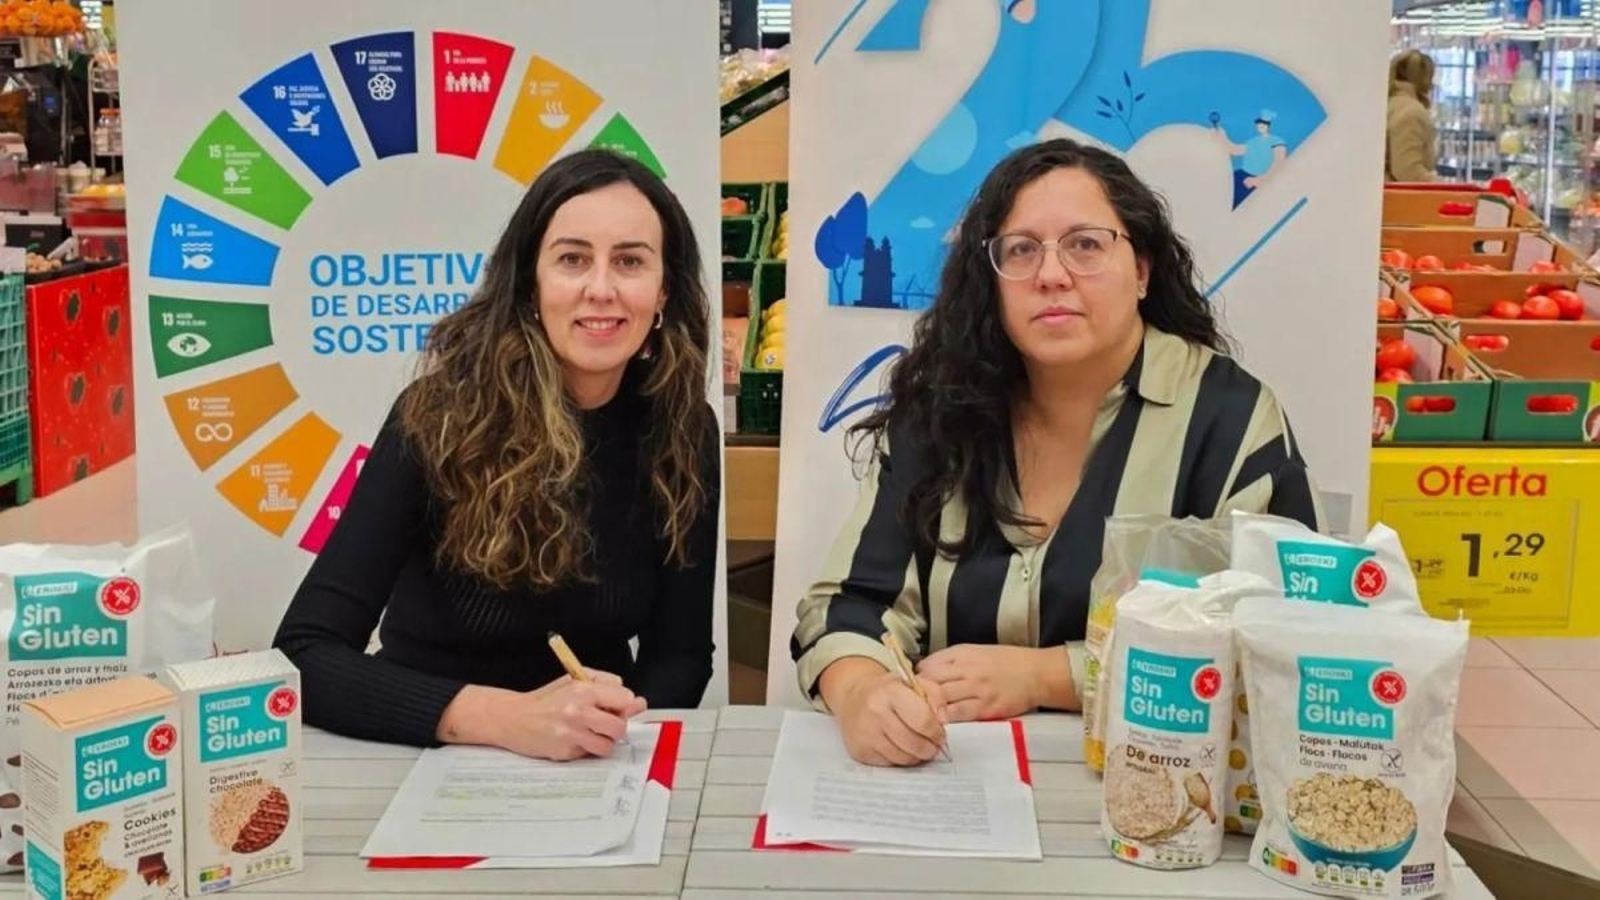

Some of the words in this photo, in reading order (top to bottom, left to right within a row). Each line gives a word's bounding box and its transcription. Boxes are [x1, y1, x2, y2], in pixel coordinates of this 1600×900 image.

[354, 51, 367, 65] 17
[443, 50, 450, 64] 1
[272, 85, 286, 99] 16
[209, 144, 221, 159] 15
[170, 223, 183, 237] 14
[310, 253, 483, 287] OBJETIV
[311, 295, 348, 317] DE
[161, 312, 174, 326] 13
[187, 397, 200, 411] 12
[250, 464, 261, 478] 11
[1417, 465, 1547, 497] Oferta
[327, 506, 341, 520] 10
[1290, 571, 1319, 594] Sin
[22, 603, 62, 627] Sin
[18, 625, 118, 650] Gluten
[7, 665, 44, 679] Copos
[47, 664, 61, 674] de
[64, 665, 92, 674] arroz
[95, 666, 101, 674] y
[1131, 675, 1162, 699] Sin
[1305, 683, 1340, 703] Sin
[1130, 696, 1204, 724] Gluten
[1304, 704, 1386, 729] Gluten
[207, 714, 239, 733] Sin
[208, 728, 281, 752] Gluten
[1126, 744, 1145, 761] De
[1149, 754, 1191, 768] arroz
[83, 758, 117, 780] Sin
[210, 770, 258, 785] Digestive
[84, 767, 160, 800] Gluten
[210, 777, 263, 793] chocolate
[124, 808, 176, 830] Cookies
